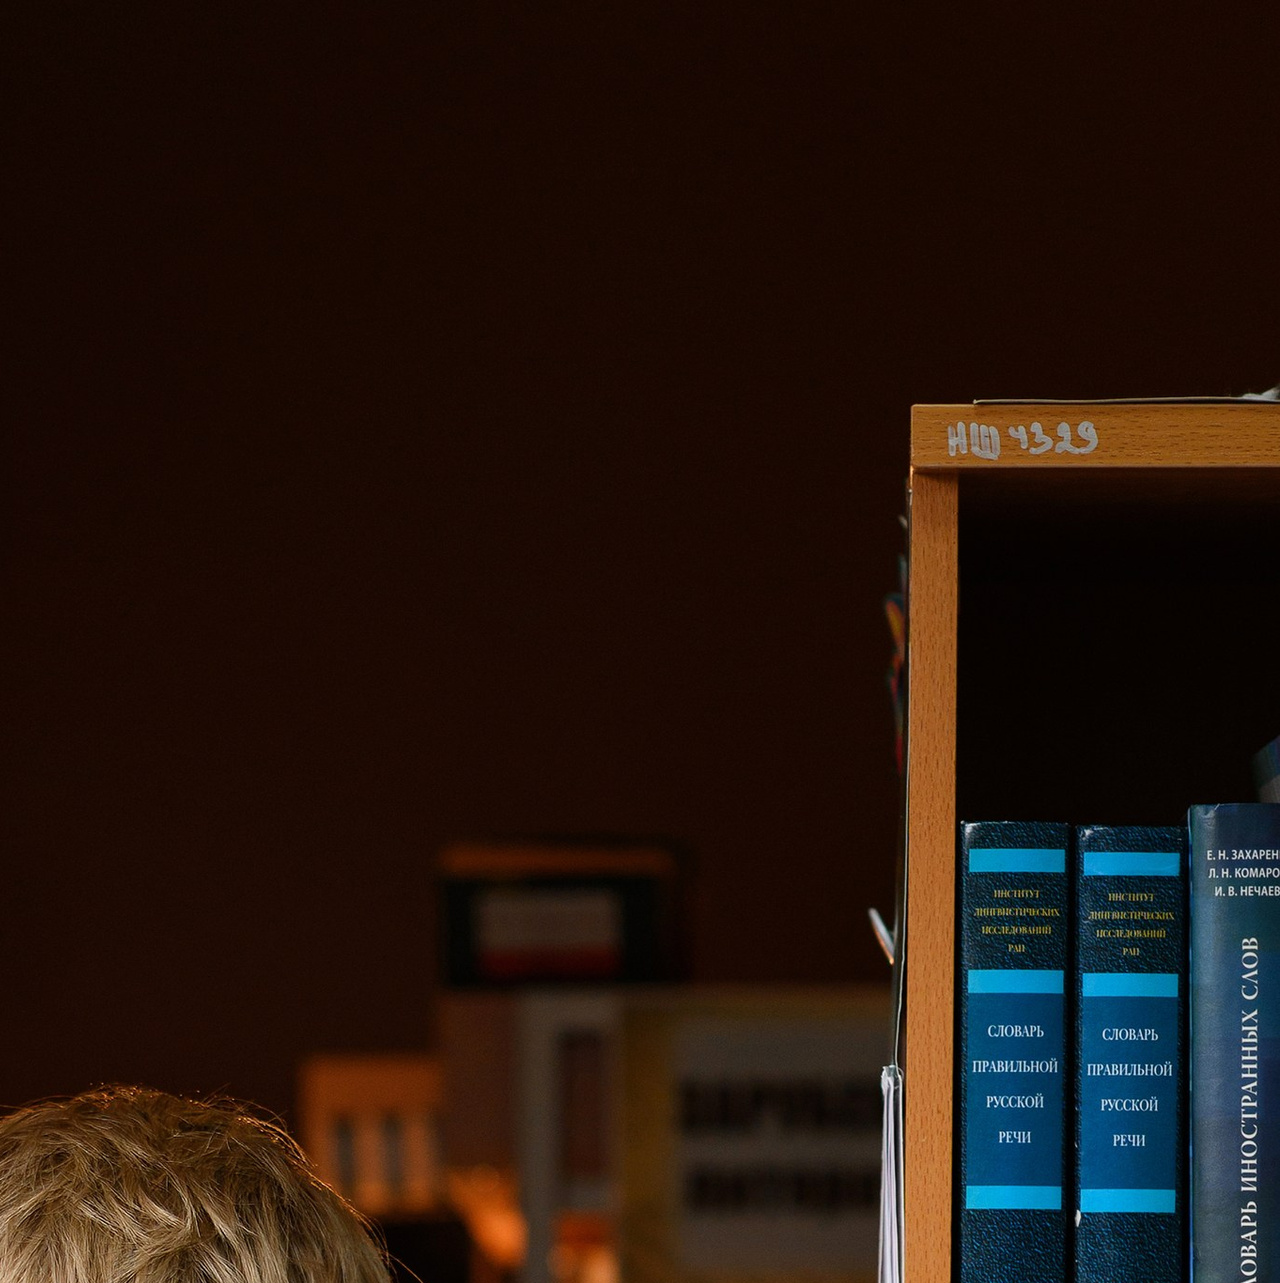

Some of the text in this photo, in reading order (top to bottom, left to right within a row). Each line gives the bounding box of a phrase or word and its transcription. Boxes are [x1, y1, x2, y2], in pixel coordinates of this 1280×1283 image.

[1207, 849, 1280, 860] Е. Н. ЗАХАРЕН
[1208, 868, 1219, 878] Л.
[1221, 868, 1232, 878] Н.
[993, 889, 1040, 899] ИНСТИТУТ
[1108, 893, 1154, 902] ИНСТИТУТ
[1214, 886, 1226, 897] И.
[1228, 886, 1238, 897] В.
[973, 907, 1060, 917] ЛИНГВИСТИЧЕСКИХ
[1088, 911, 1175, 920] ЛИНГВИСТИЧЕСКИХ
[981, 924, 1052, 935] ИССЛЕДОВАНИЙ
[1096, 928, 1166, 938] ИССЛЕДОВАНИЙ
[1241, 936, 1259, 1001] СЛОВ
[987, 1025, 1044, 1038] СЛОВАРЬ
[1102, 1028, 1159, 1041] СЛОВАРЬ
[972, 1058, 1058, 1073] ПРАВИЛЬНОЙ
[1087, 1061, 1173, 1076] ПРАВИЛЬНОЙ
[986, 1093, 1044, 1108] РУССКОЙ
[1101, 1096, 1158, 1112] РУССКОЙ
[1240, 1009, 1259, 1192] ИНОСТРАННЫХ
[998, 1131, 1031, 1144] РЕЧИ
[1113, 1134, 1146, 1147] РЕЧИ
